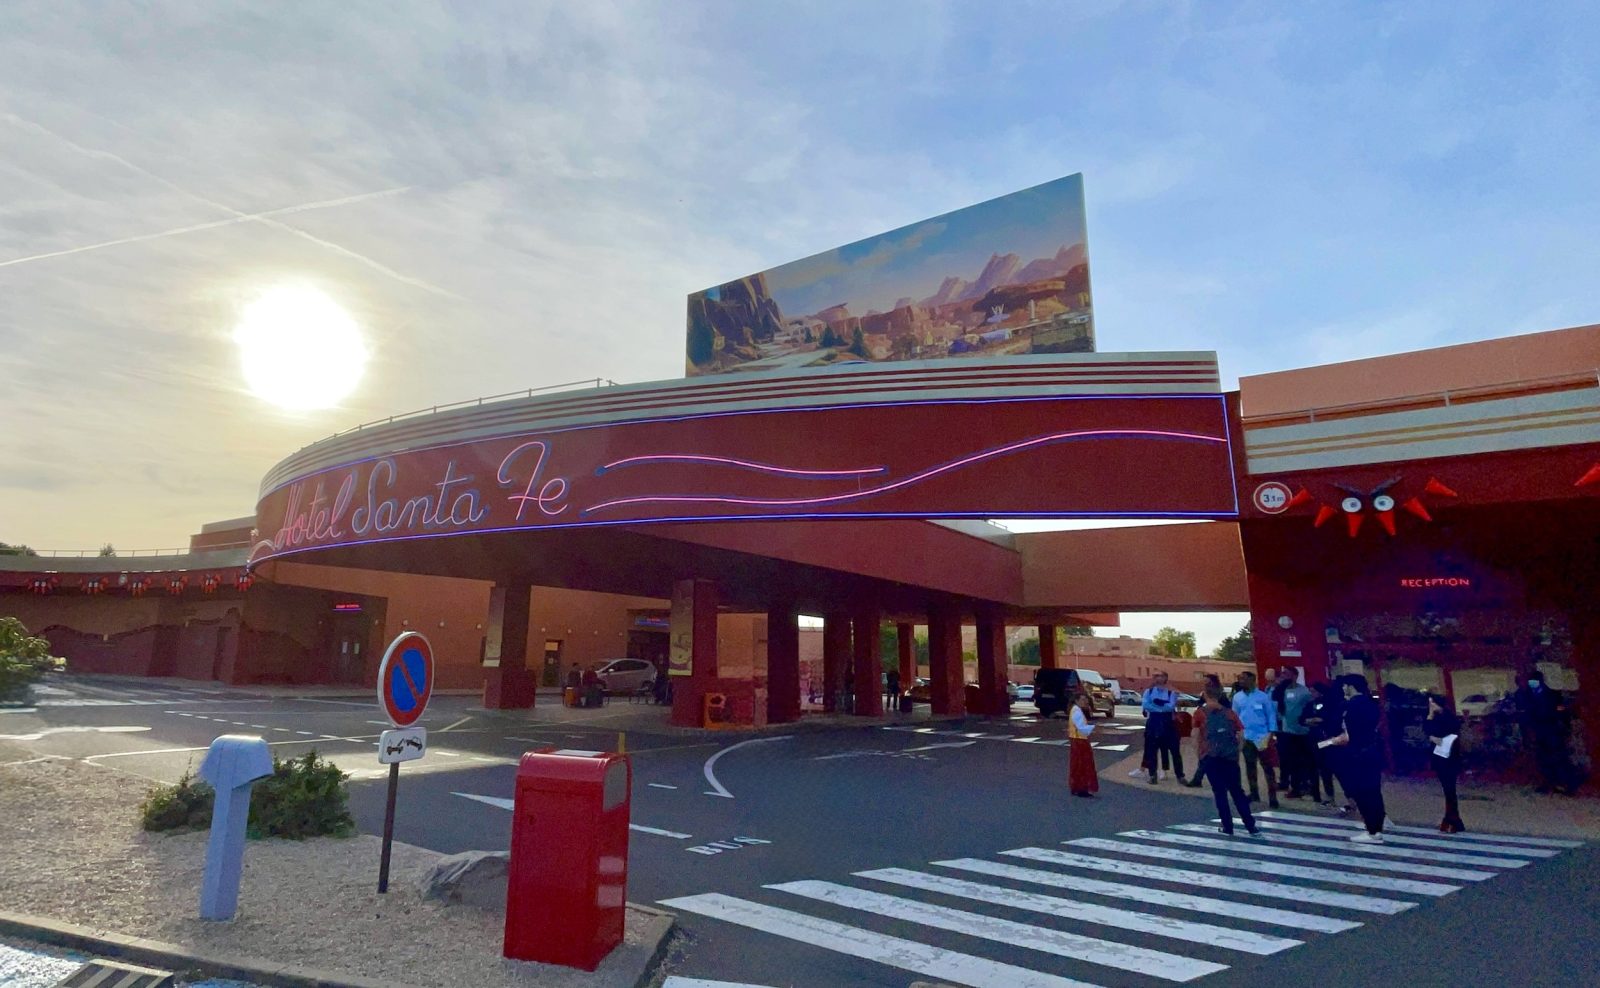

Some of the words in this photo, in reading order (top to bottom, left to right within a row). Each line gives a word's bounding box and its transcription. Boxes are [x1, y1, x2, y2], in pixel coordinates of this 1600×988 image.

[266, 471, 356, 549] Hotel
[352, 459, 488, 535] Santa
[496, 440, 568, 521] Fe
[1401, 578, 1470, 588] RECEPTION
[685, 836, 772, 856] BUS
